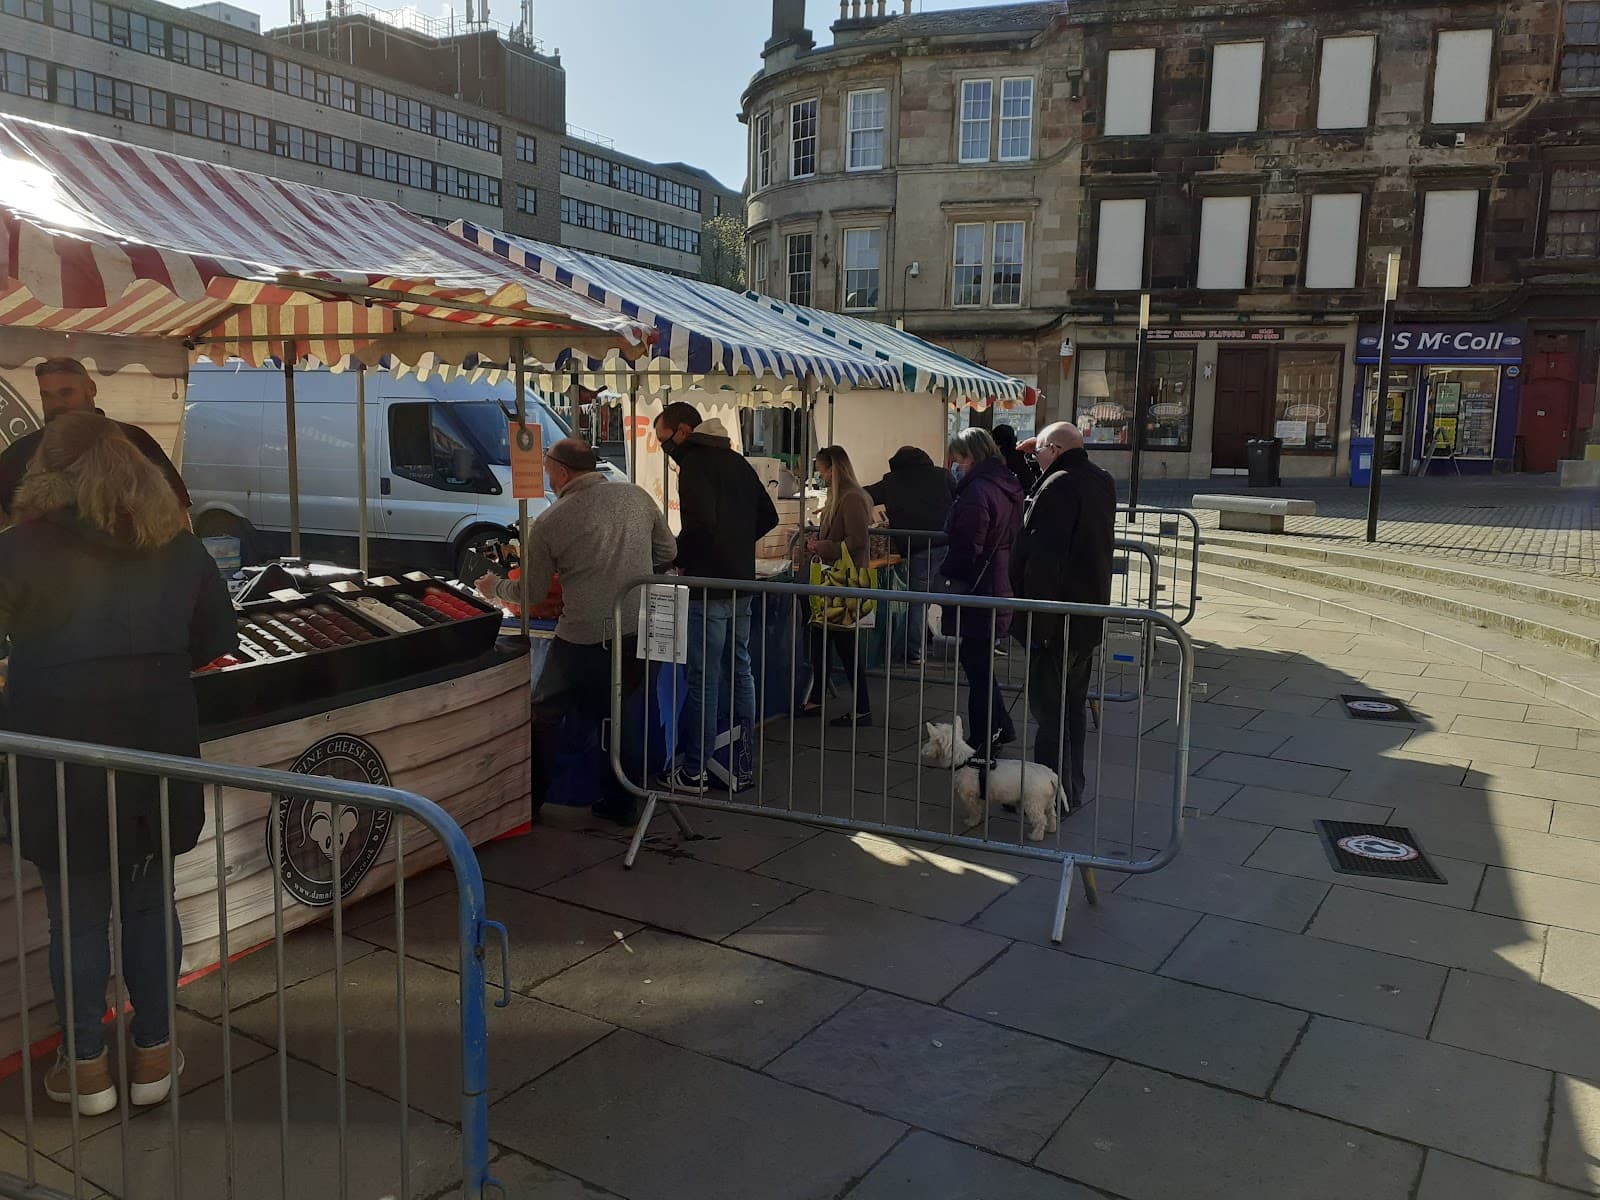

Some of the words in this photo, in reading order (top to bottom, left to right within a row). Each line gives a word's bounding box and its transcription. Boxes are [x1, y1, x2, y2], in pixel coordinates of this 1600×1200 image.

[1417, 332, 1504, 350] McColl
[296, 747, 323, 774] FINE
[326, 740, 368, 761] CHEESE
